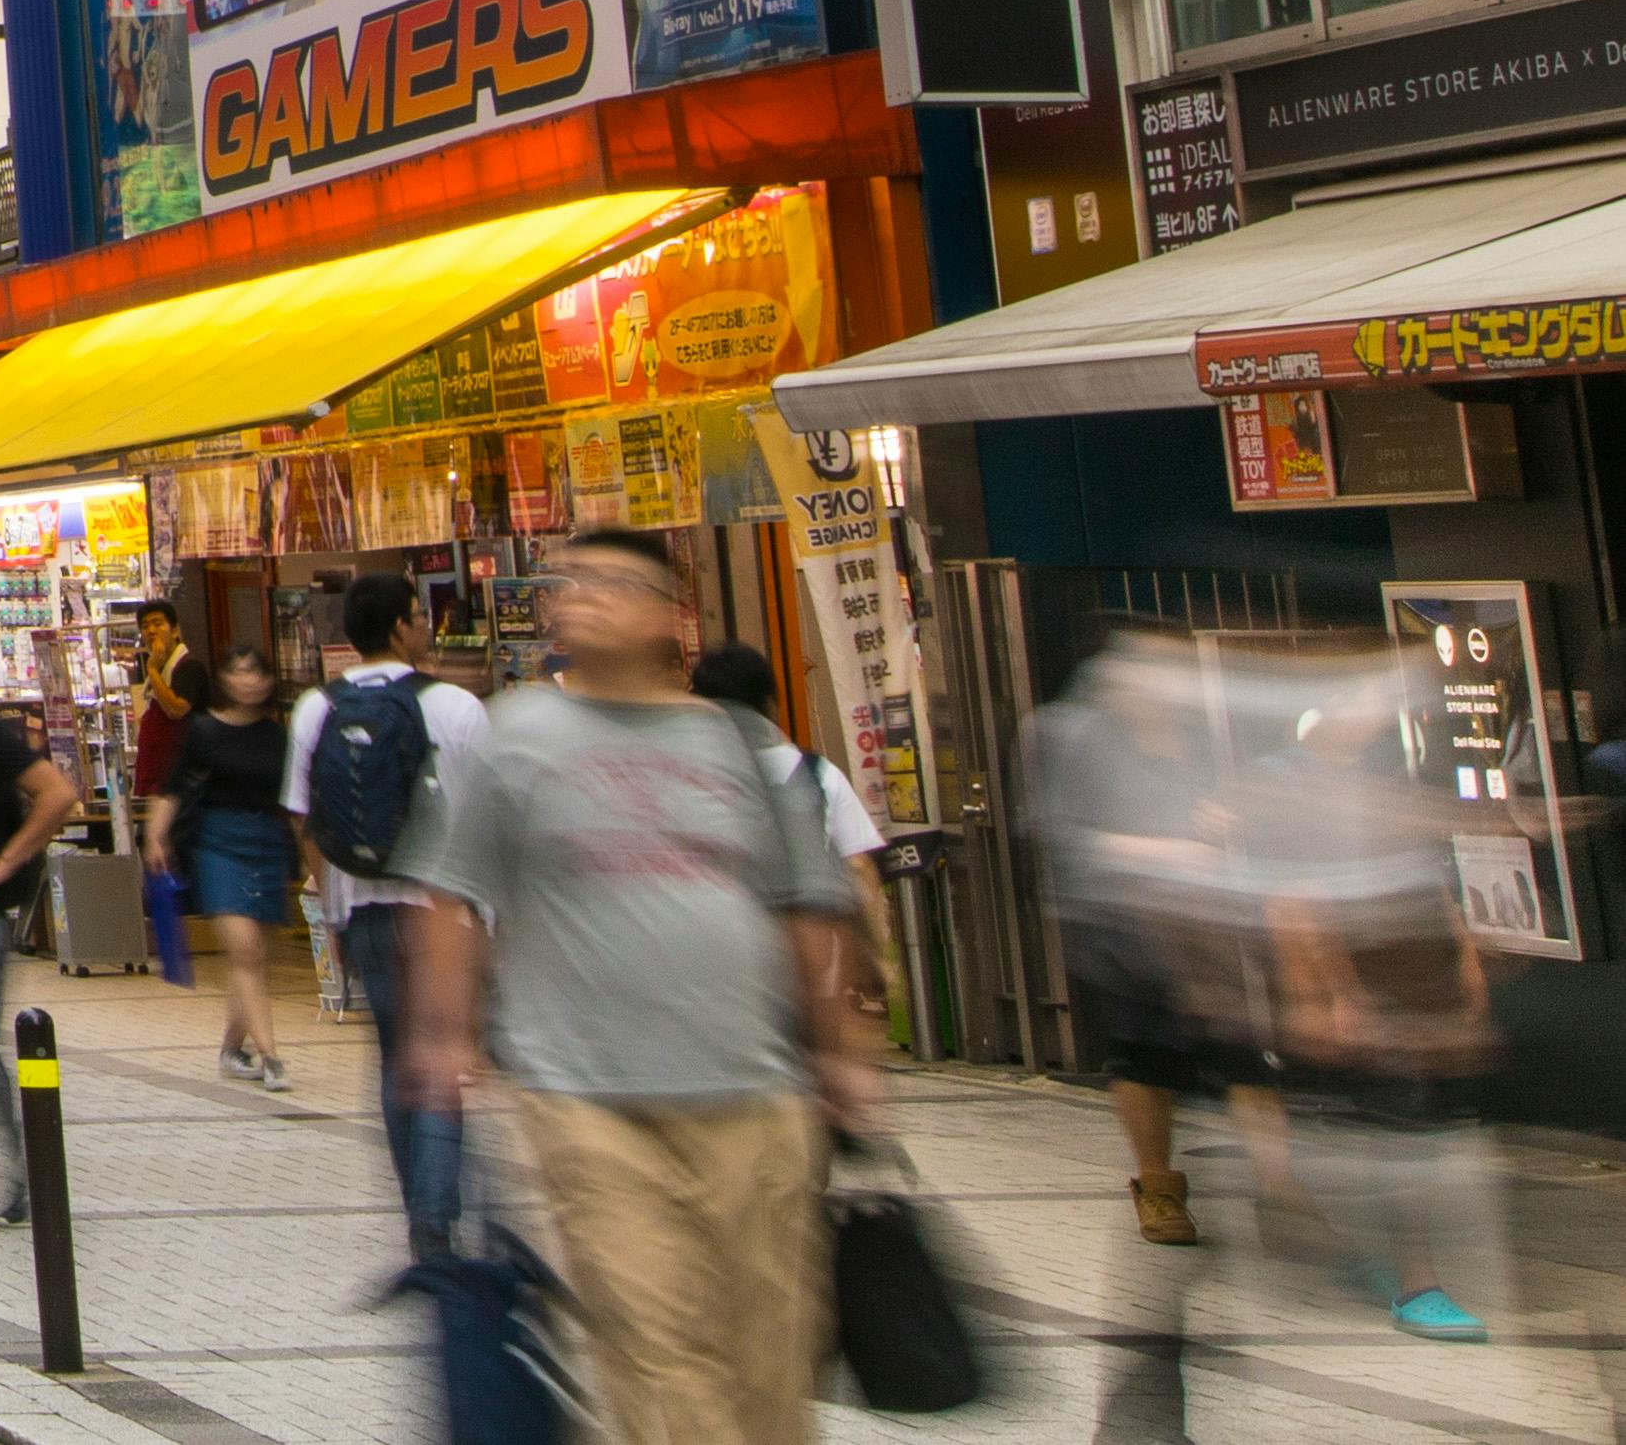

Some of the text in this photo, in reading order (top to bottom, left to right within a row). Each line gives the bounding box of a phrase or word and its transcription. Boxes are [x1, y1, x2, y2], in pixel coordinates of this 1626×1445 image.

[1268, 50, 1569, 129] ALIENWARE STORE AKIBA
[1141, 90, 1227, 135] お部屋探し
[1156, 205, 1218, 240] 当ビル 8F
[1207, 352, 1321, 388] カードゲーム専門店
[1233, 415, 1263, 438] 鉄道
[1235, 436, 1266, 459] 模型
[1238, 460, 1267, 480] TOY
[1445, 700, 1499, 715] STORE AKIBA
